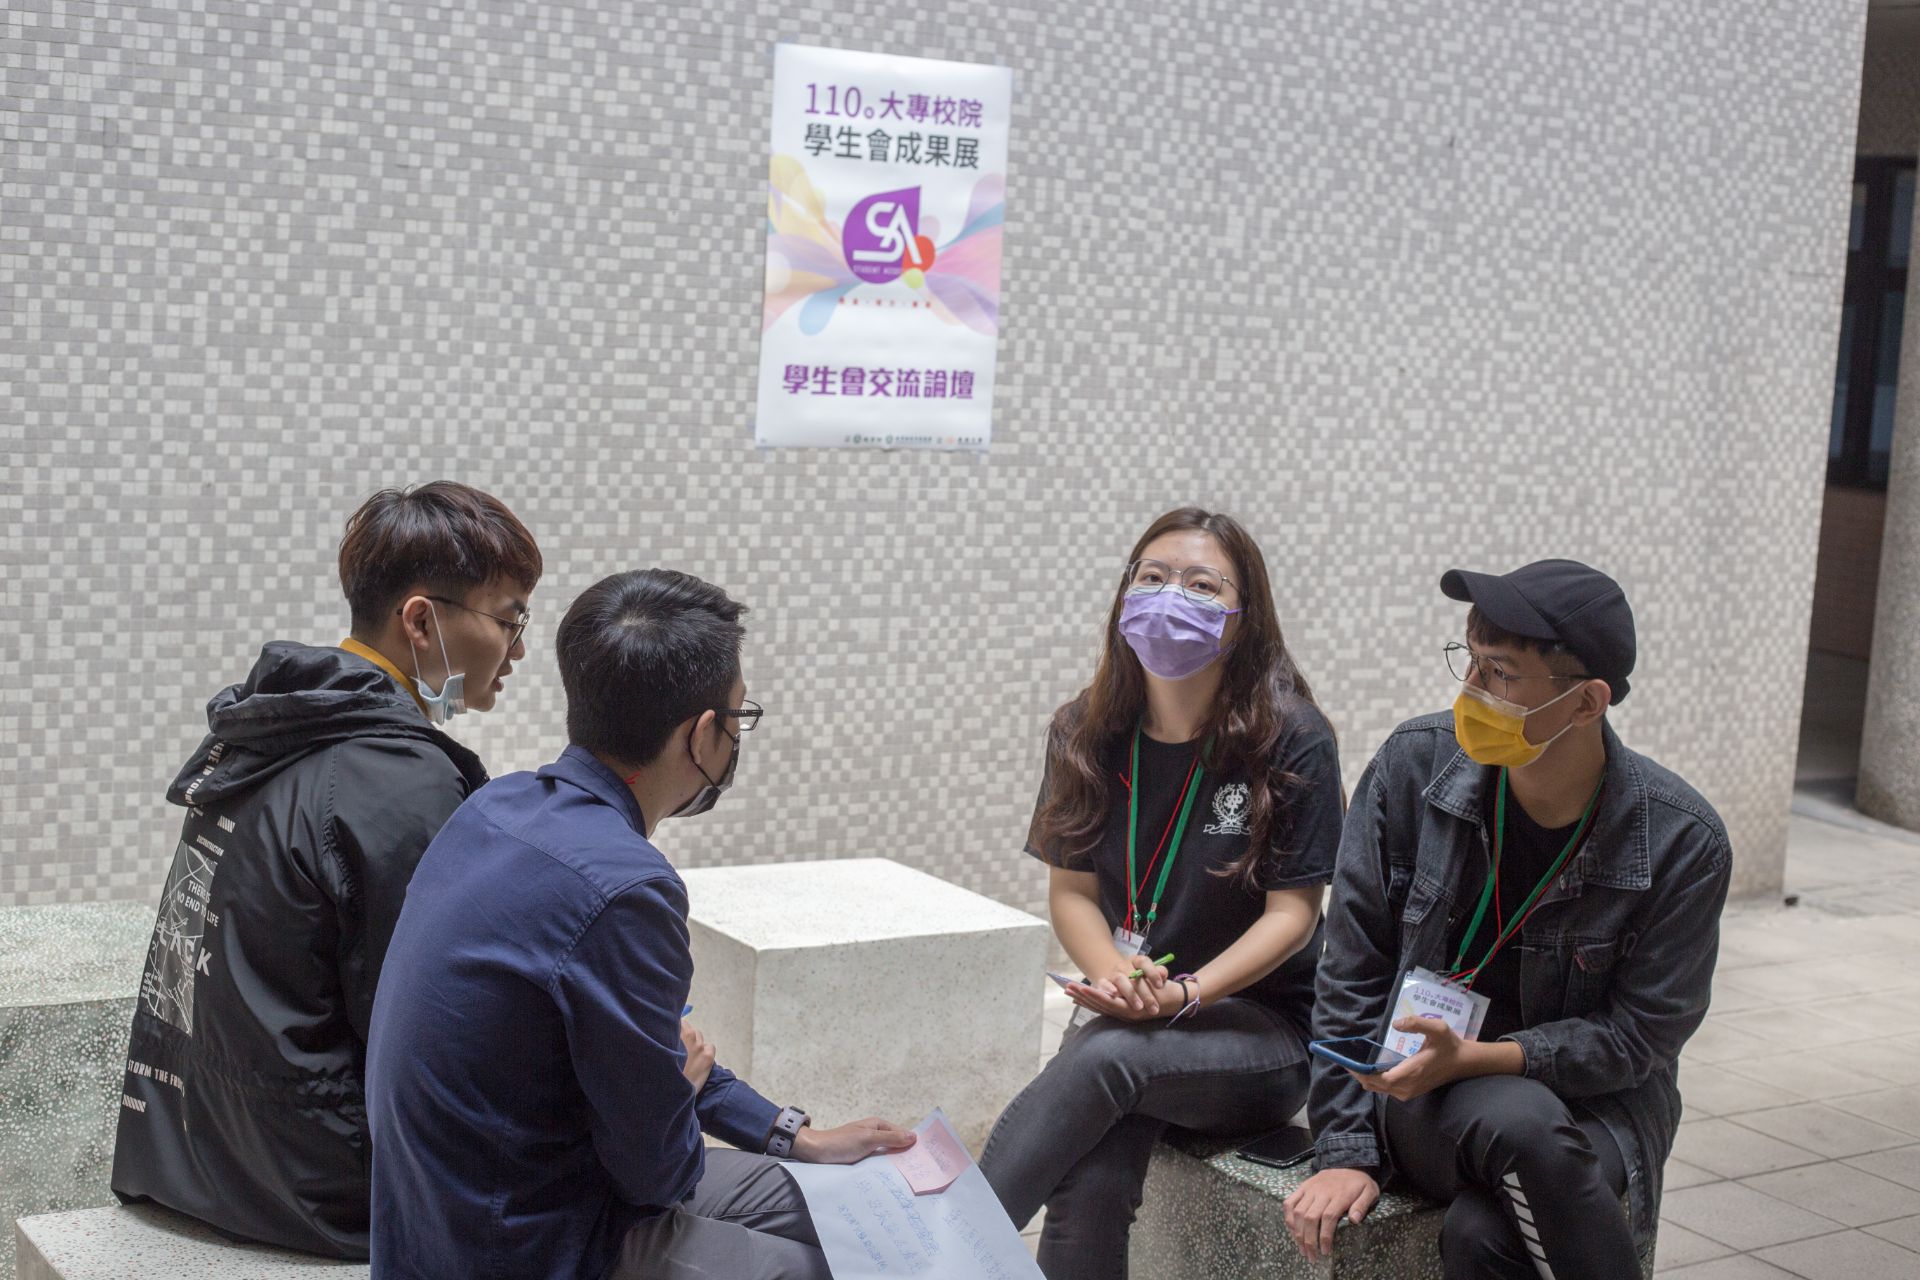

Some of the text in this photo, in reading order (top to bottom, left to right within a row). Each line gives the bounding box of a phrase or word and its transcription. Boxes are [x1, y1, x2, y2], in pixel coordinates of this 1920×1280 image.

[804, 122, 979, 169] 學生會成果展
[783, 364, 975, 399] 學生會交流論壇
[177, 890, 219, 928] NO END TO LIFE
[128, 1059, 152, 1077] STORM
[154, 1068, 169, 1083] THE
